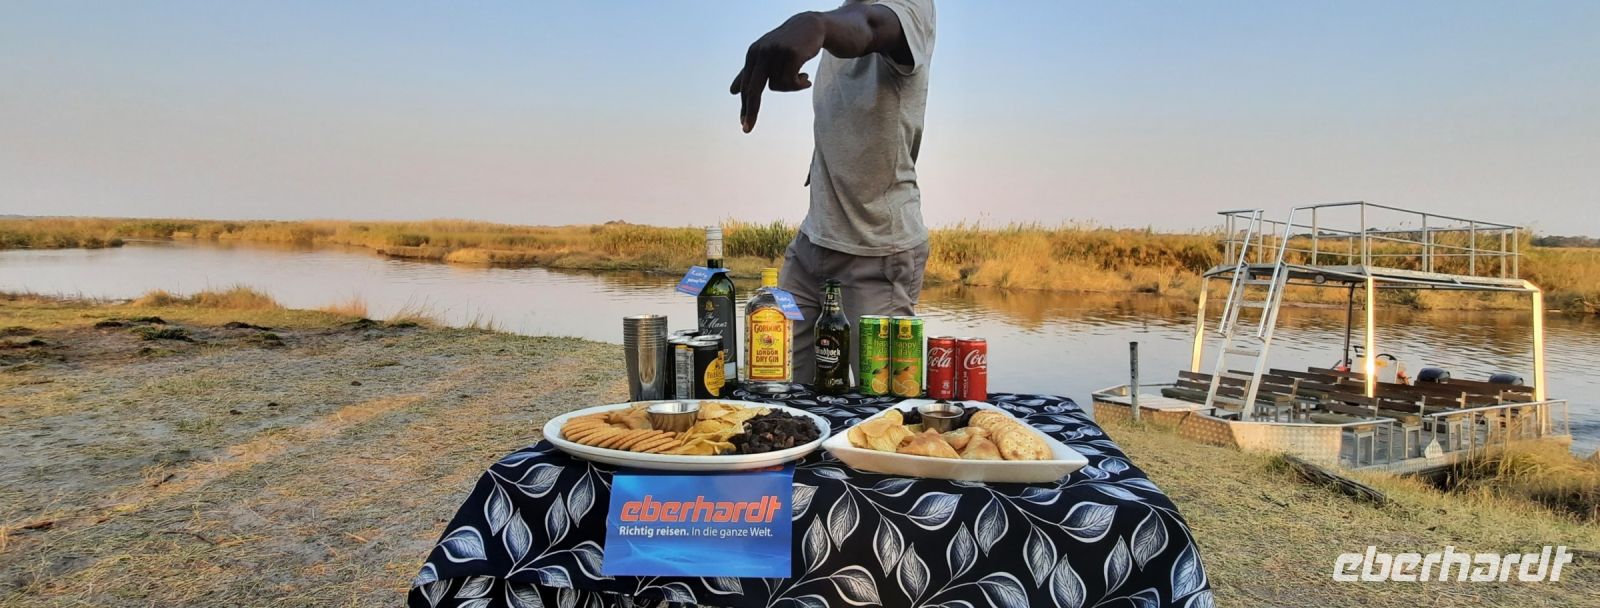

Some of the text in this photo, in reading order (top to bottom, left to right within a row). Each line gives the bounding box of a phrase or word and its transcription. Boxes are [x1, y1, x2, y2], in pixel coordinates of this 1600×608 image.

[620, 495, 782, 523] eberhardt
[619, 525, 773, 539] Richtig reisen. In die ganze Welt.
